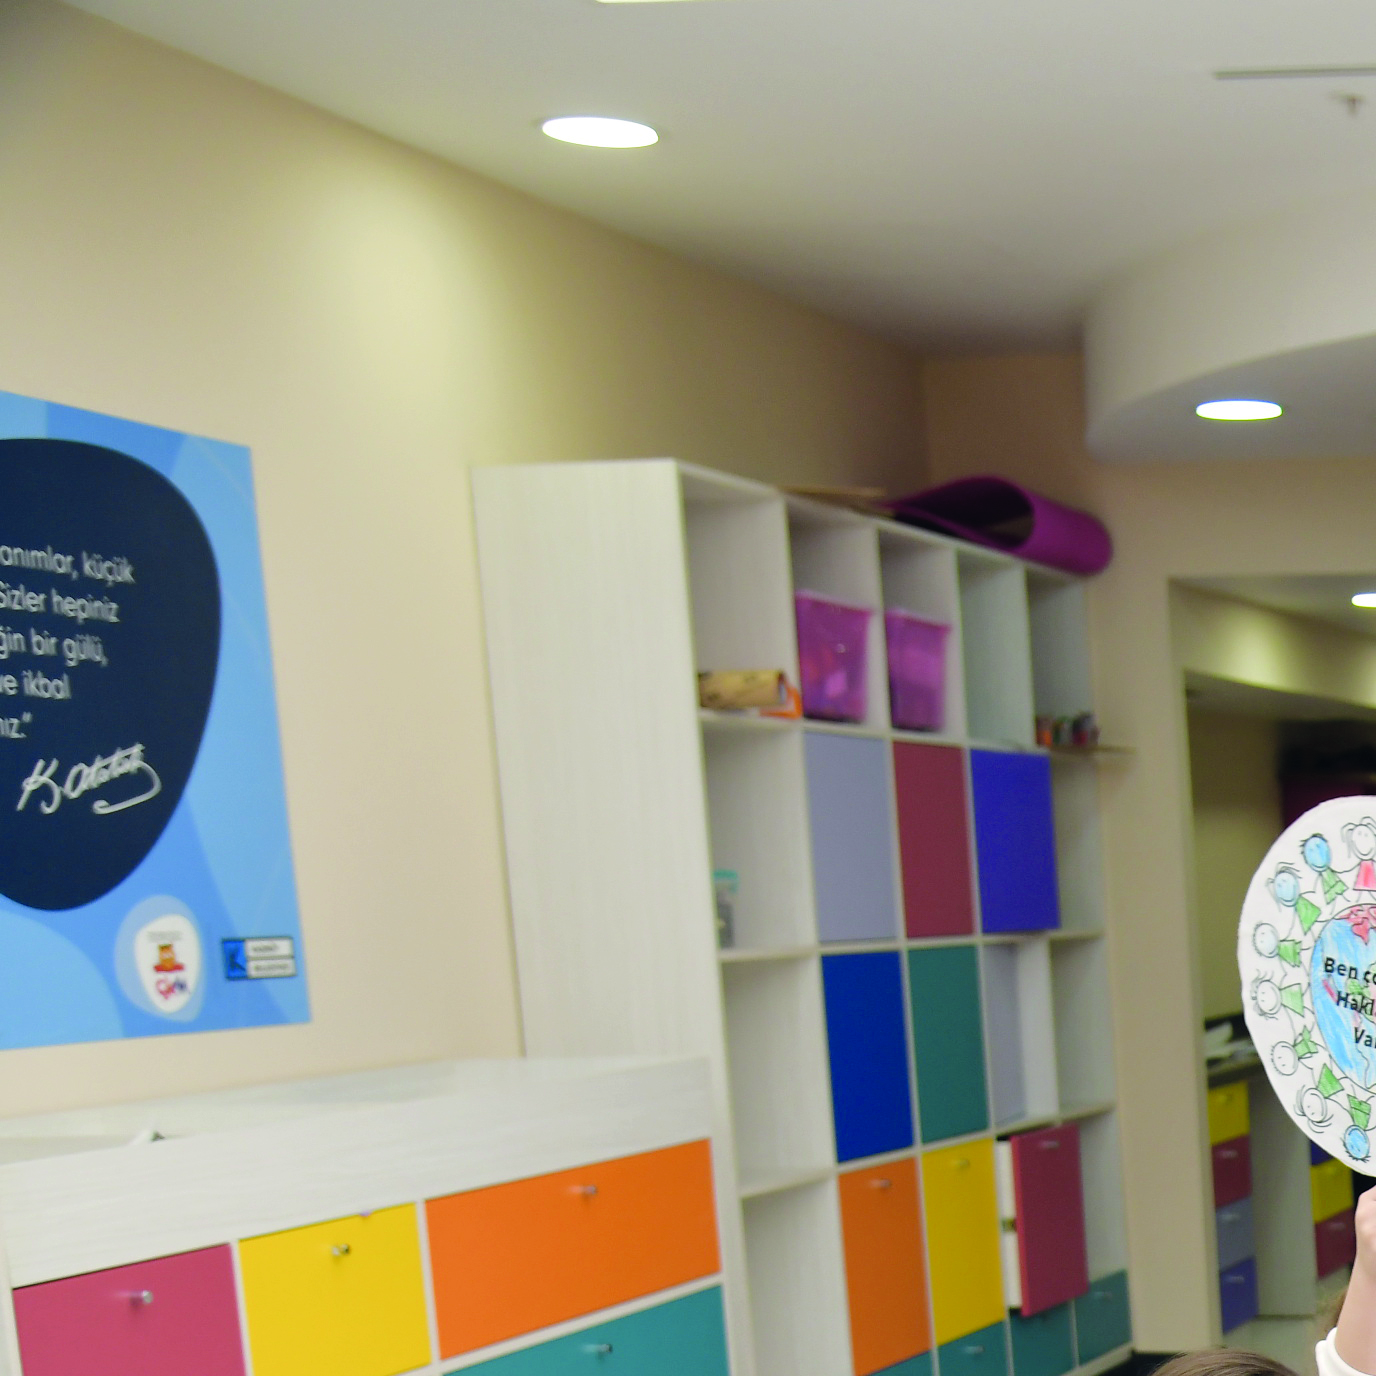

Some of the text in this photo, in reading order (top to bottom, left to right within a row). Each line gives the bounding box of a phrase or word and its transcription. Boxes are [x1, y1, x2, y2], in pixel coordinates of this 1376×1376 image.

[82, 550, 136, 588] küçük
[51, 587, 121, 626] hepiniz
[30, 626, 58, 657] bir
[62, 633, 109, 668] gülü,
[1324, 956, 1358, 981] Ben
